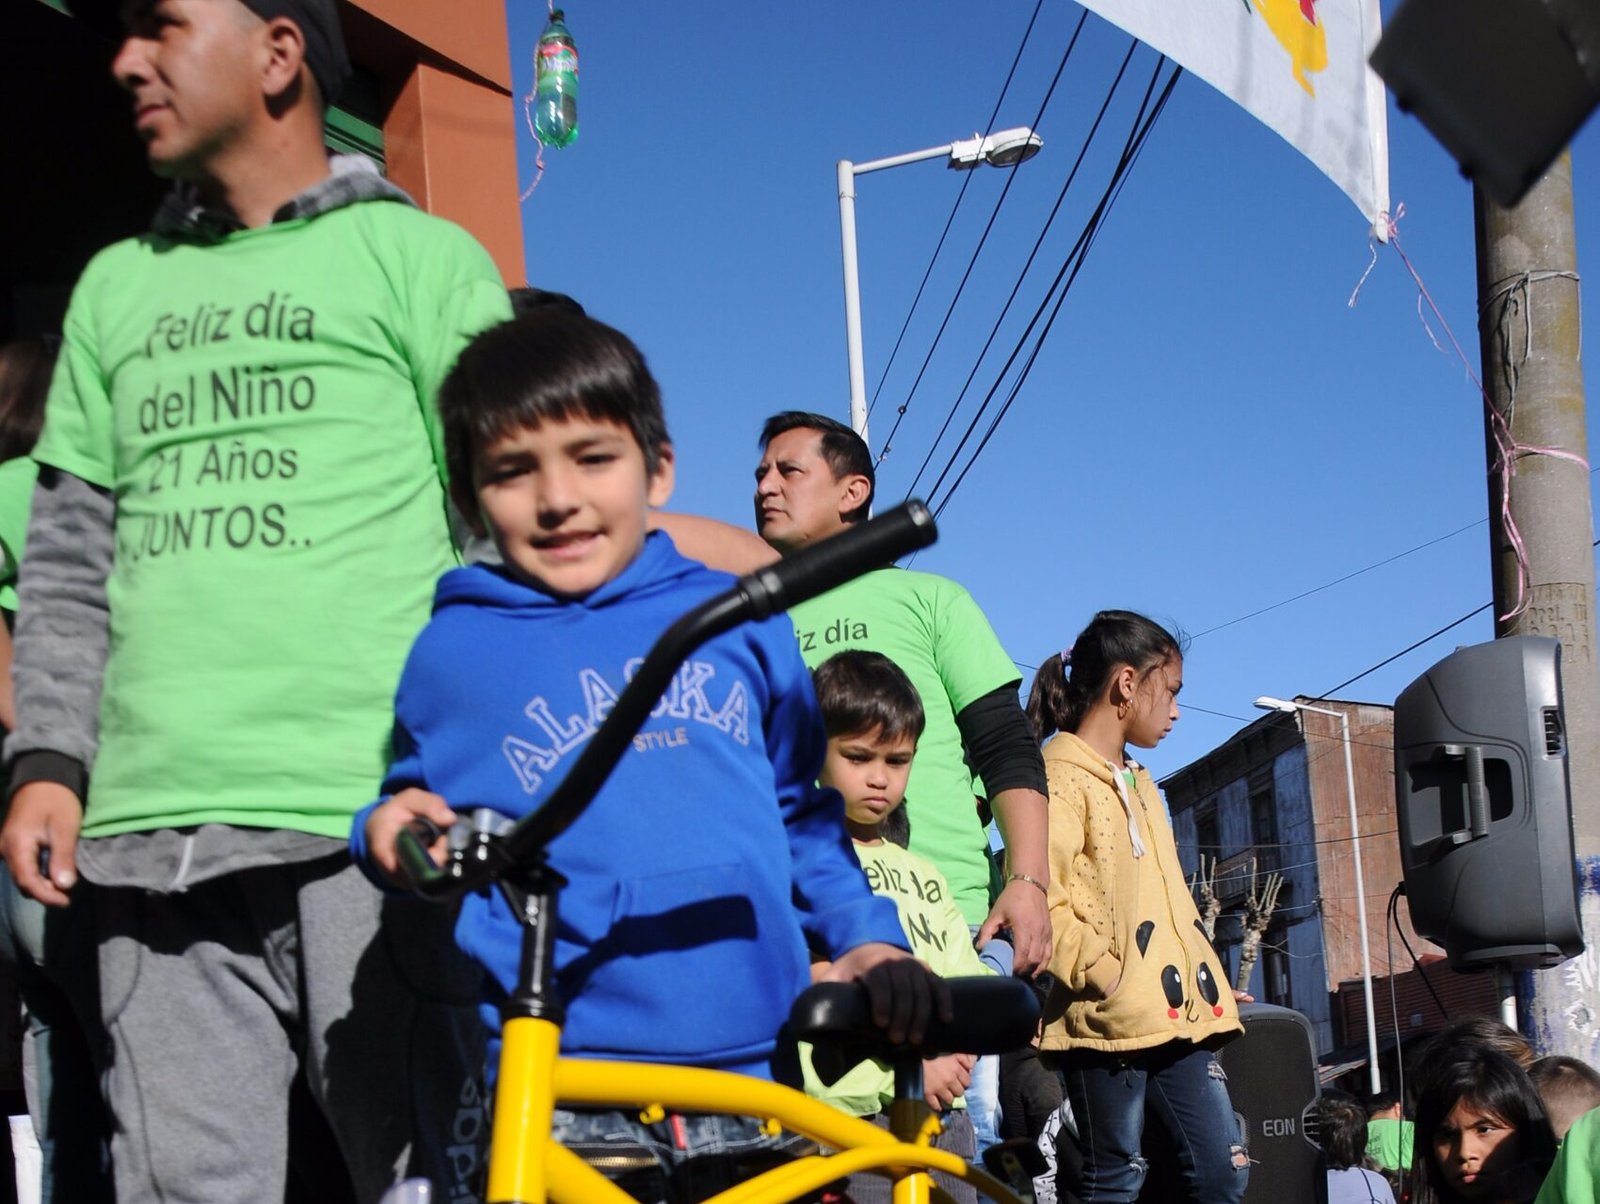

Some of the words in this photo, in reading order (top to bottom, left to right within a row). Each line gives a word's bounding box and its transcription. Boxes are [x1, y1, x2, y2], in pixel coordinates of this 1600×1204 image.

[144, 303, 233, 359] Feliz
[244, 290, 316, 343] día
[138, 374, 195, 435] del
[210, 364, 316, 424] Niño
[148, 444, 183, 494] 21
[195, 441, 299, 486] Años
[824, 617, 869, 645] día
[632, 726, 689, 753] STYLE
[863, 858, 910, 895] eliz
[1262, 1117, 1296, 1137] EON
